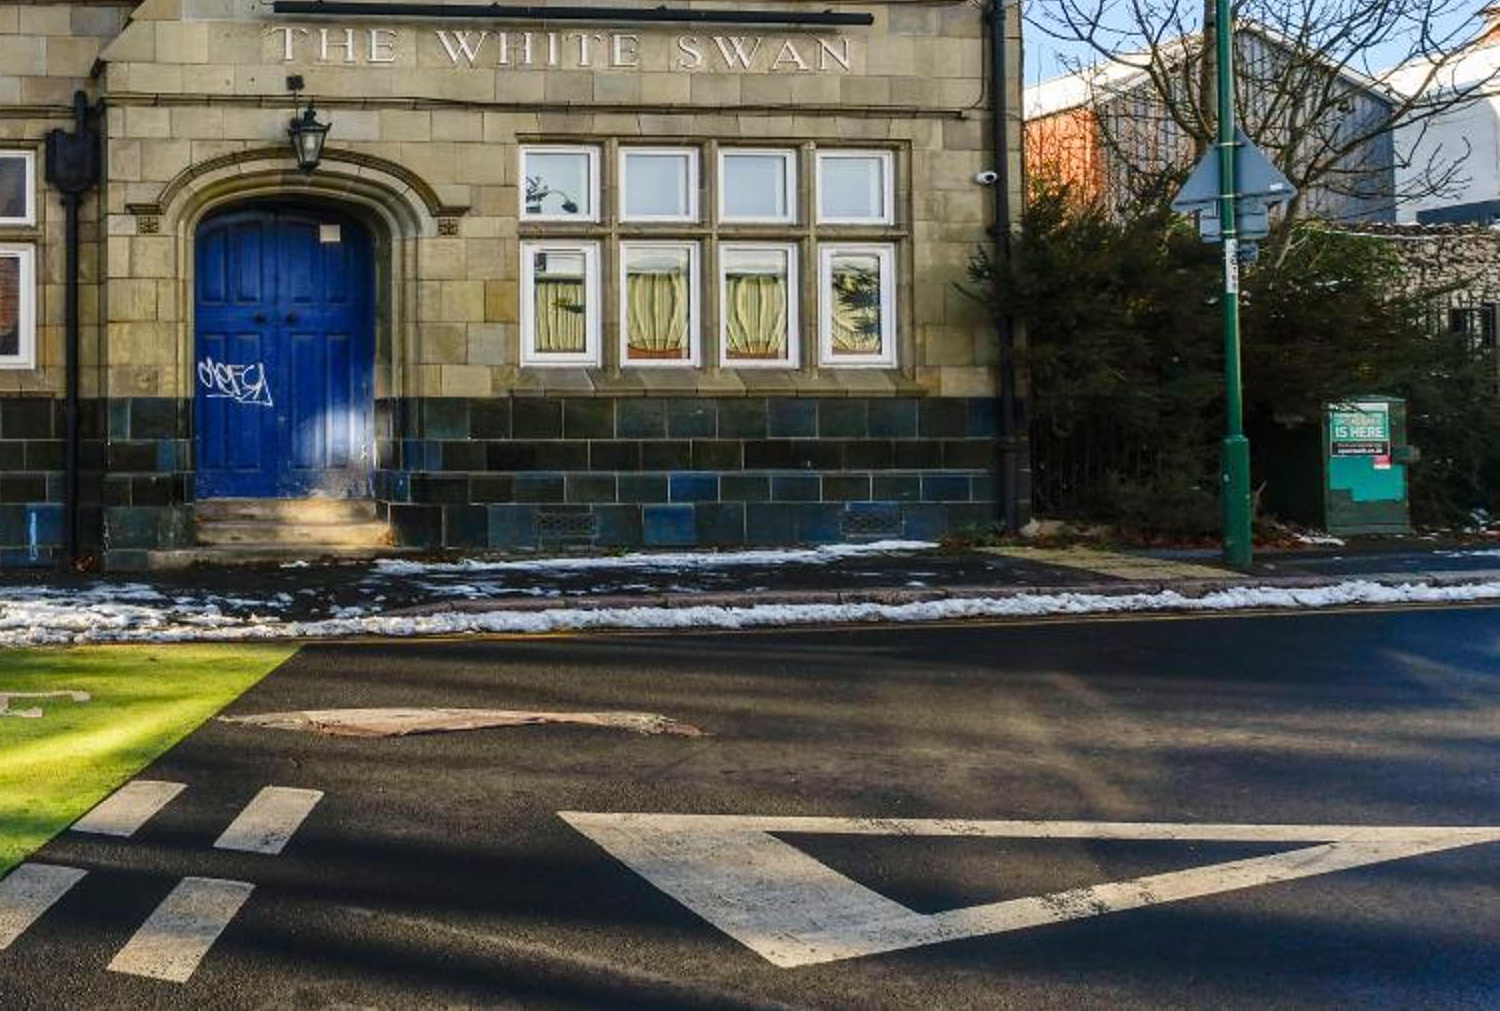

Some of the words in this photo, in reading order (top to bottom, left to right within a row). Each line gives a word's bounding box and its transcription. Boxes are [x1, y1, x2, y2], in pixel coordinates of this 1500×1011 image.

[272, 26, 399, 64] THE
[435, 29, 641, 68] WHITE
[676, 34, 855, 72] SWAN
[1335, 426, 1349, 438] IS
[1349, 426, 1385, 438] HERE
